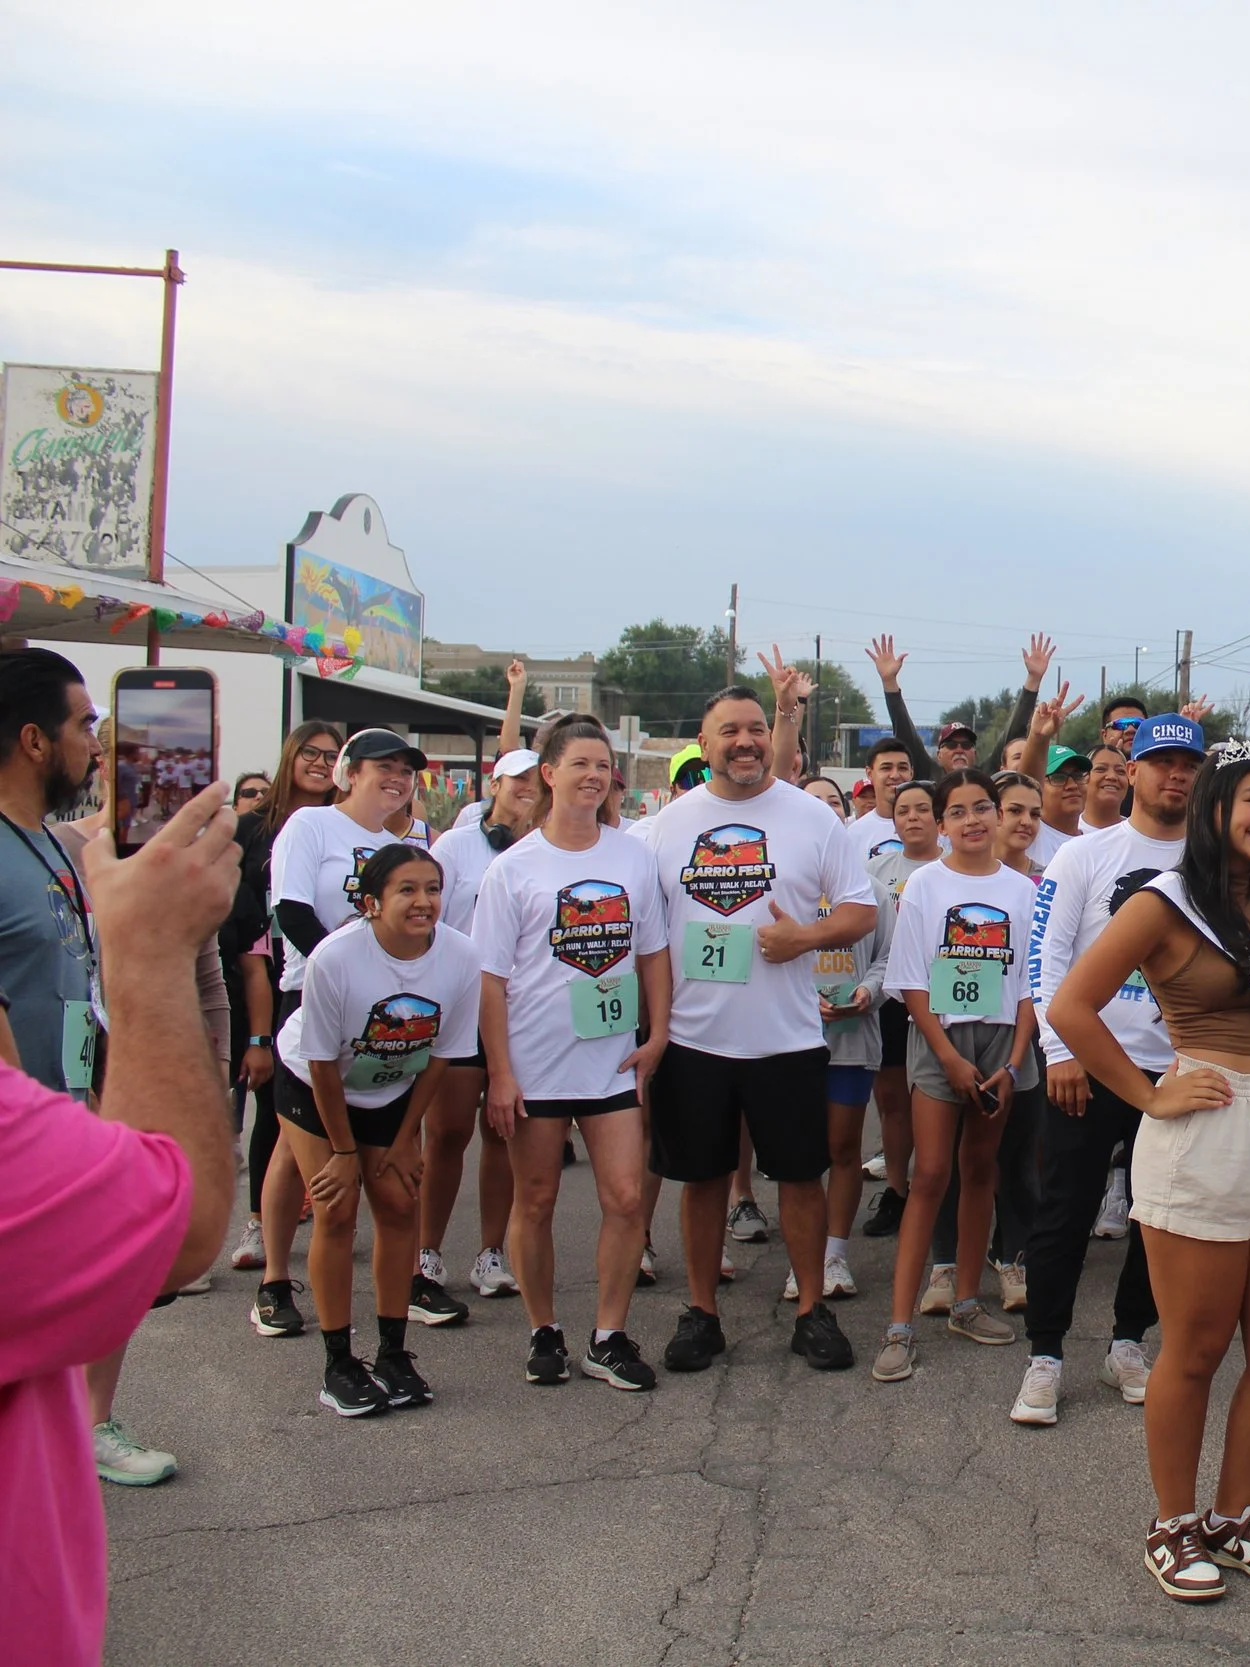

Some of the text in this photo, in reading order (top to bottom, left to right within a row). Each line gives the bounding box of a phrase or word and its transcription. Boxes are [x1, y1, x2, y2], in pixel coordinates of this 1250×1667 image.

[1152, 724, 1193, 741] CINCH
[681, 864, 773, 882] BARRIO FEST
[689, 883, 699, 891] 5K
[699, 882, 715, 890] RUN
[720, 881, 740, 889] WALK
[744, 880, 767, 888] RELAY
[551, 922, 633, 944] BARRIO FEST
[566, 942, 582, 951] RUN
[586, 940, 607, 949] WALK
[938, 945, 1013, 963] BARRIO FEST
[701, 945, 725, 968] 21
[952, 980, 980, 1003] 68
[596, 998, 622, 1023] 19
[371, 1069, 405, 1084] 69
